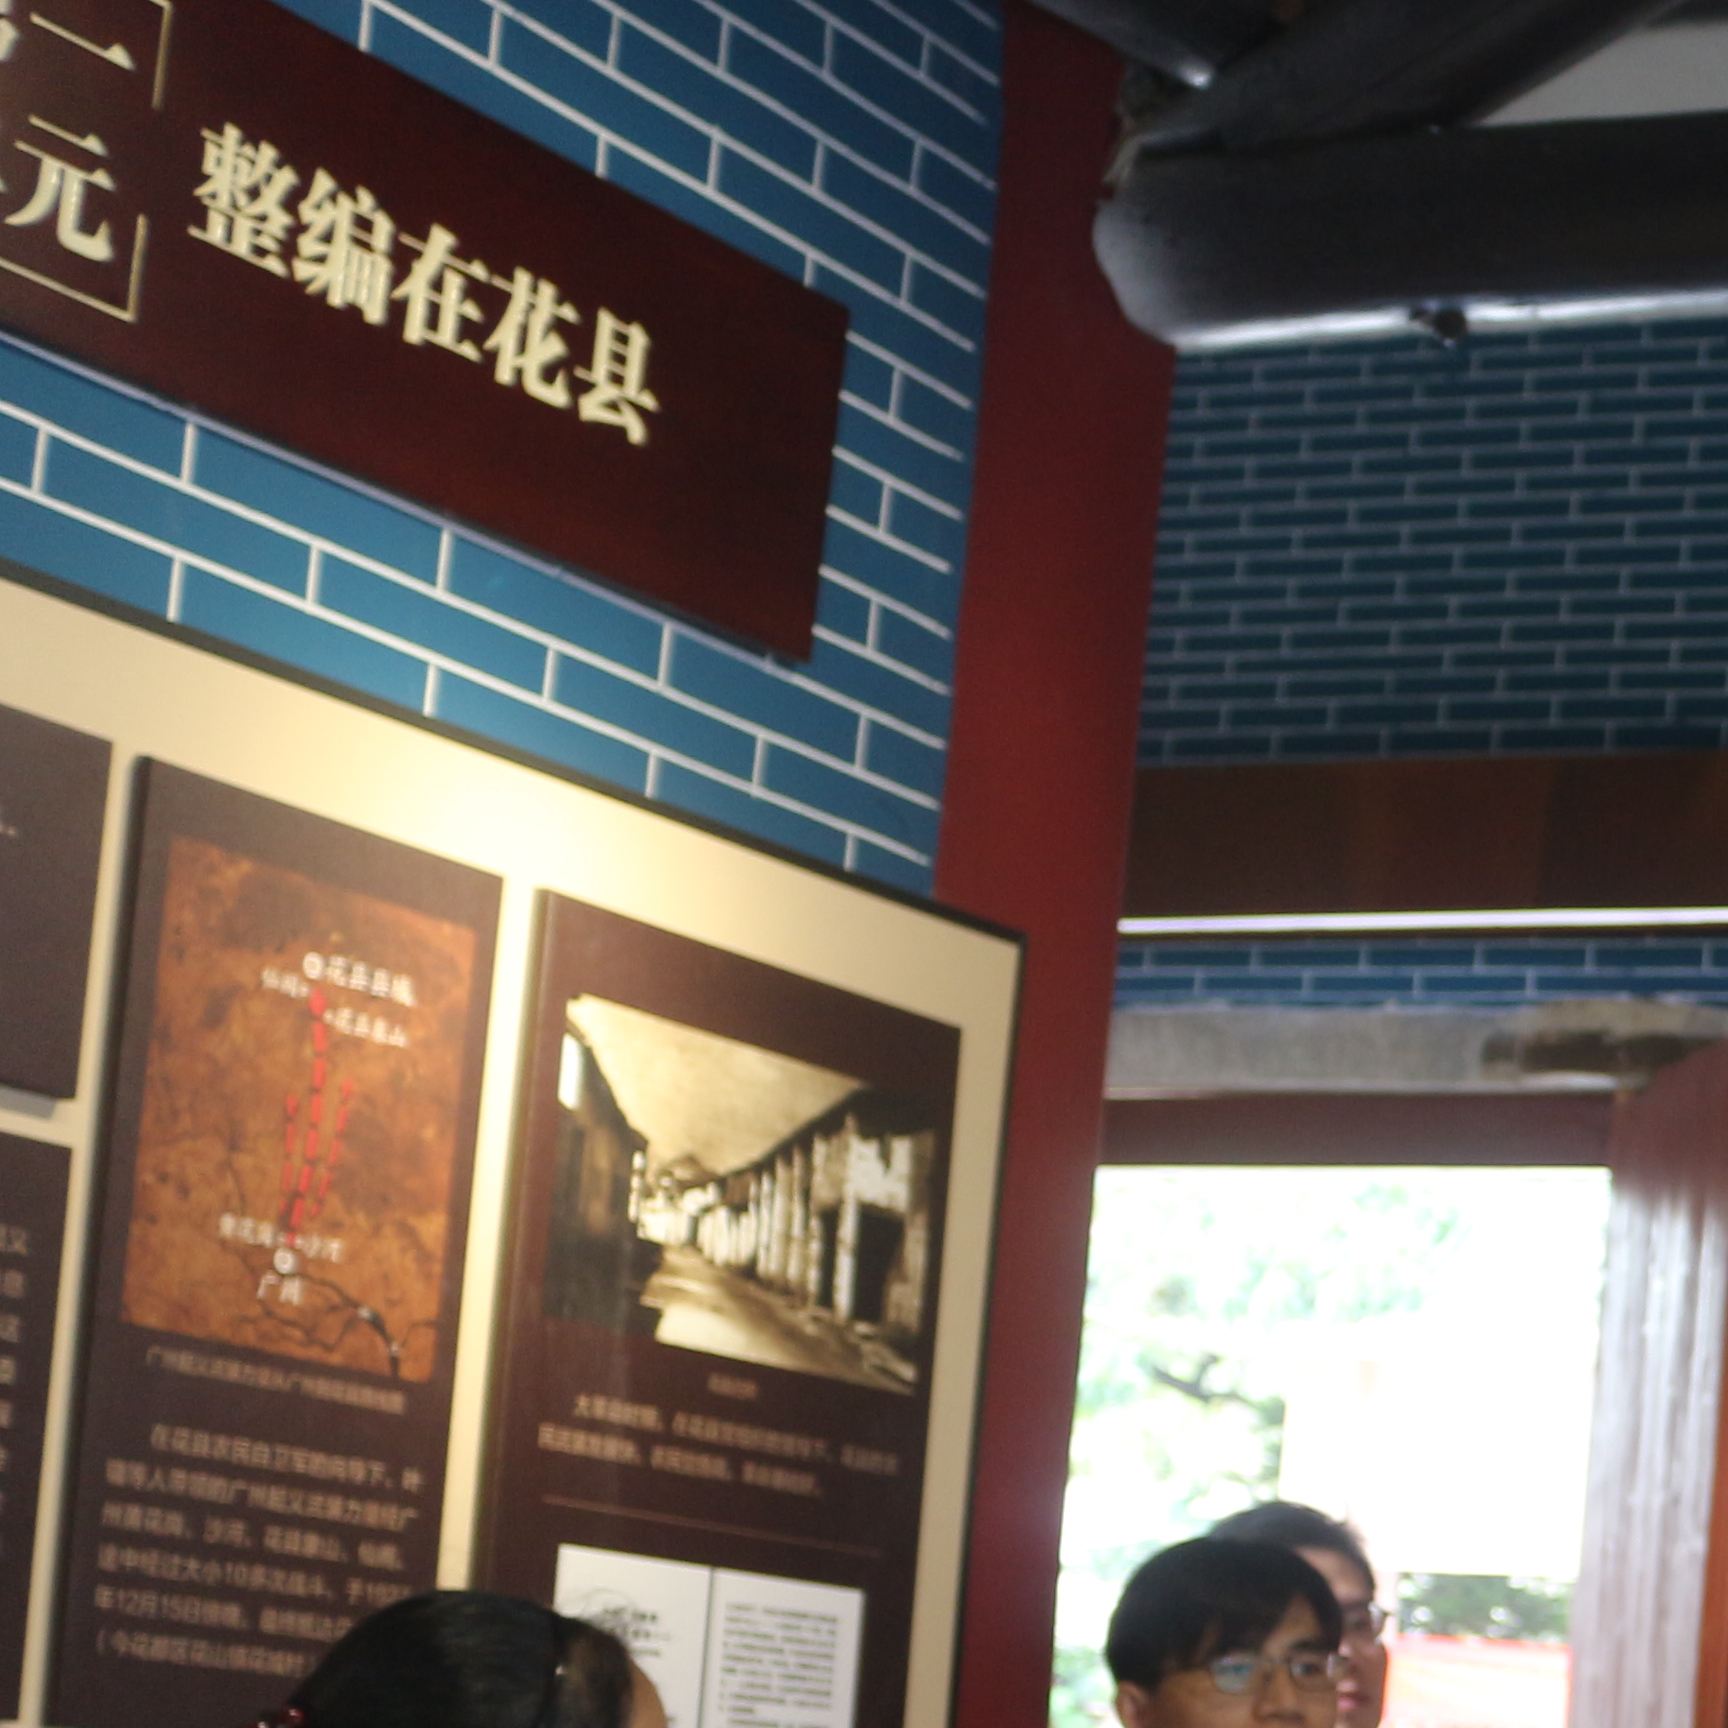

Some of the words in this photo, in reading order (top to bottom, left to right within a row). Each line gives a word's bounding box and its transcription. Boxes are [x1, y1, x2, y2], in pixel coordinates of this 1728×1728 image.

[0, 113, 117, 263] 元
[187, 122, 661, 446] 整编在花县
